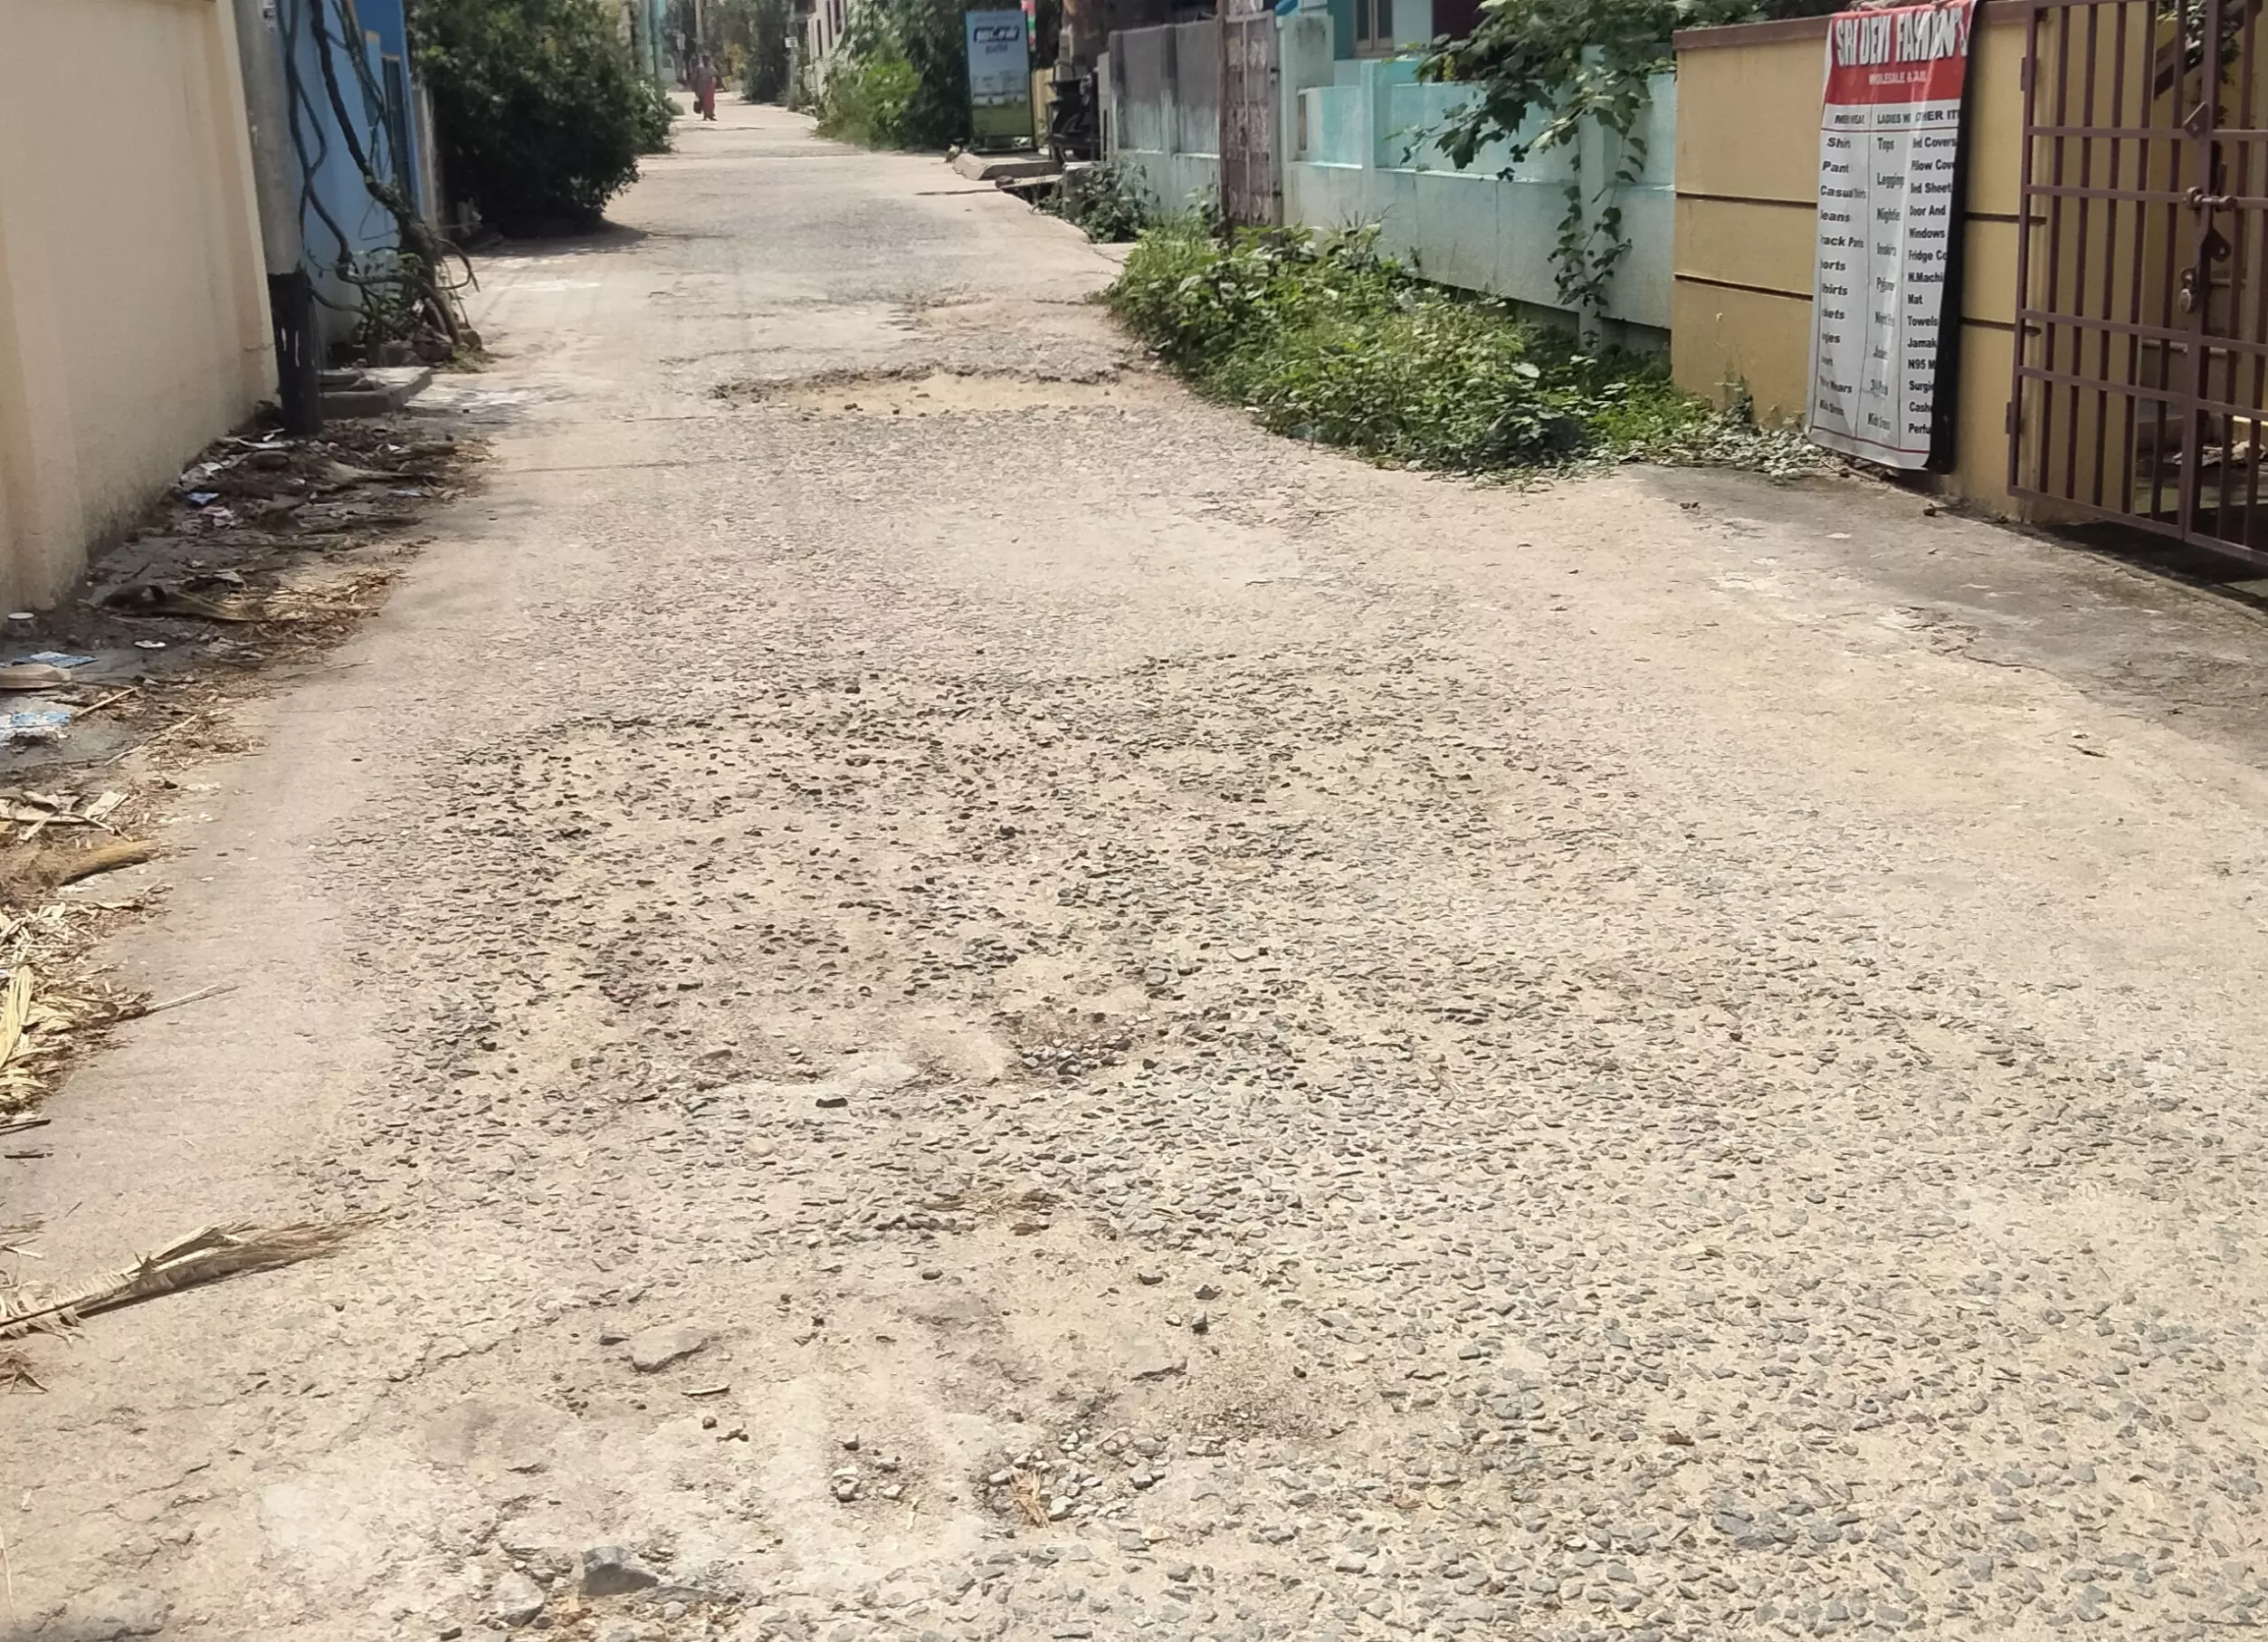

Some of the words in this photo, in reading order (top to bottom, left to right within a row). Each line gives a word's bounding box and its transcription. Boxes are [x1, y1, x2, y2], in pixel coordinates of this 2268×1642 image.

[1929, 205, 1946, 216] And
[1908, 293, 1923, 304] Mat
[1908, 358, 1926, 369] N95
